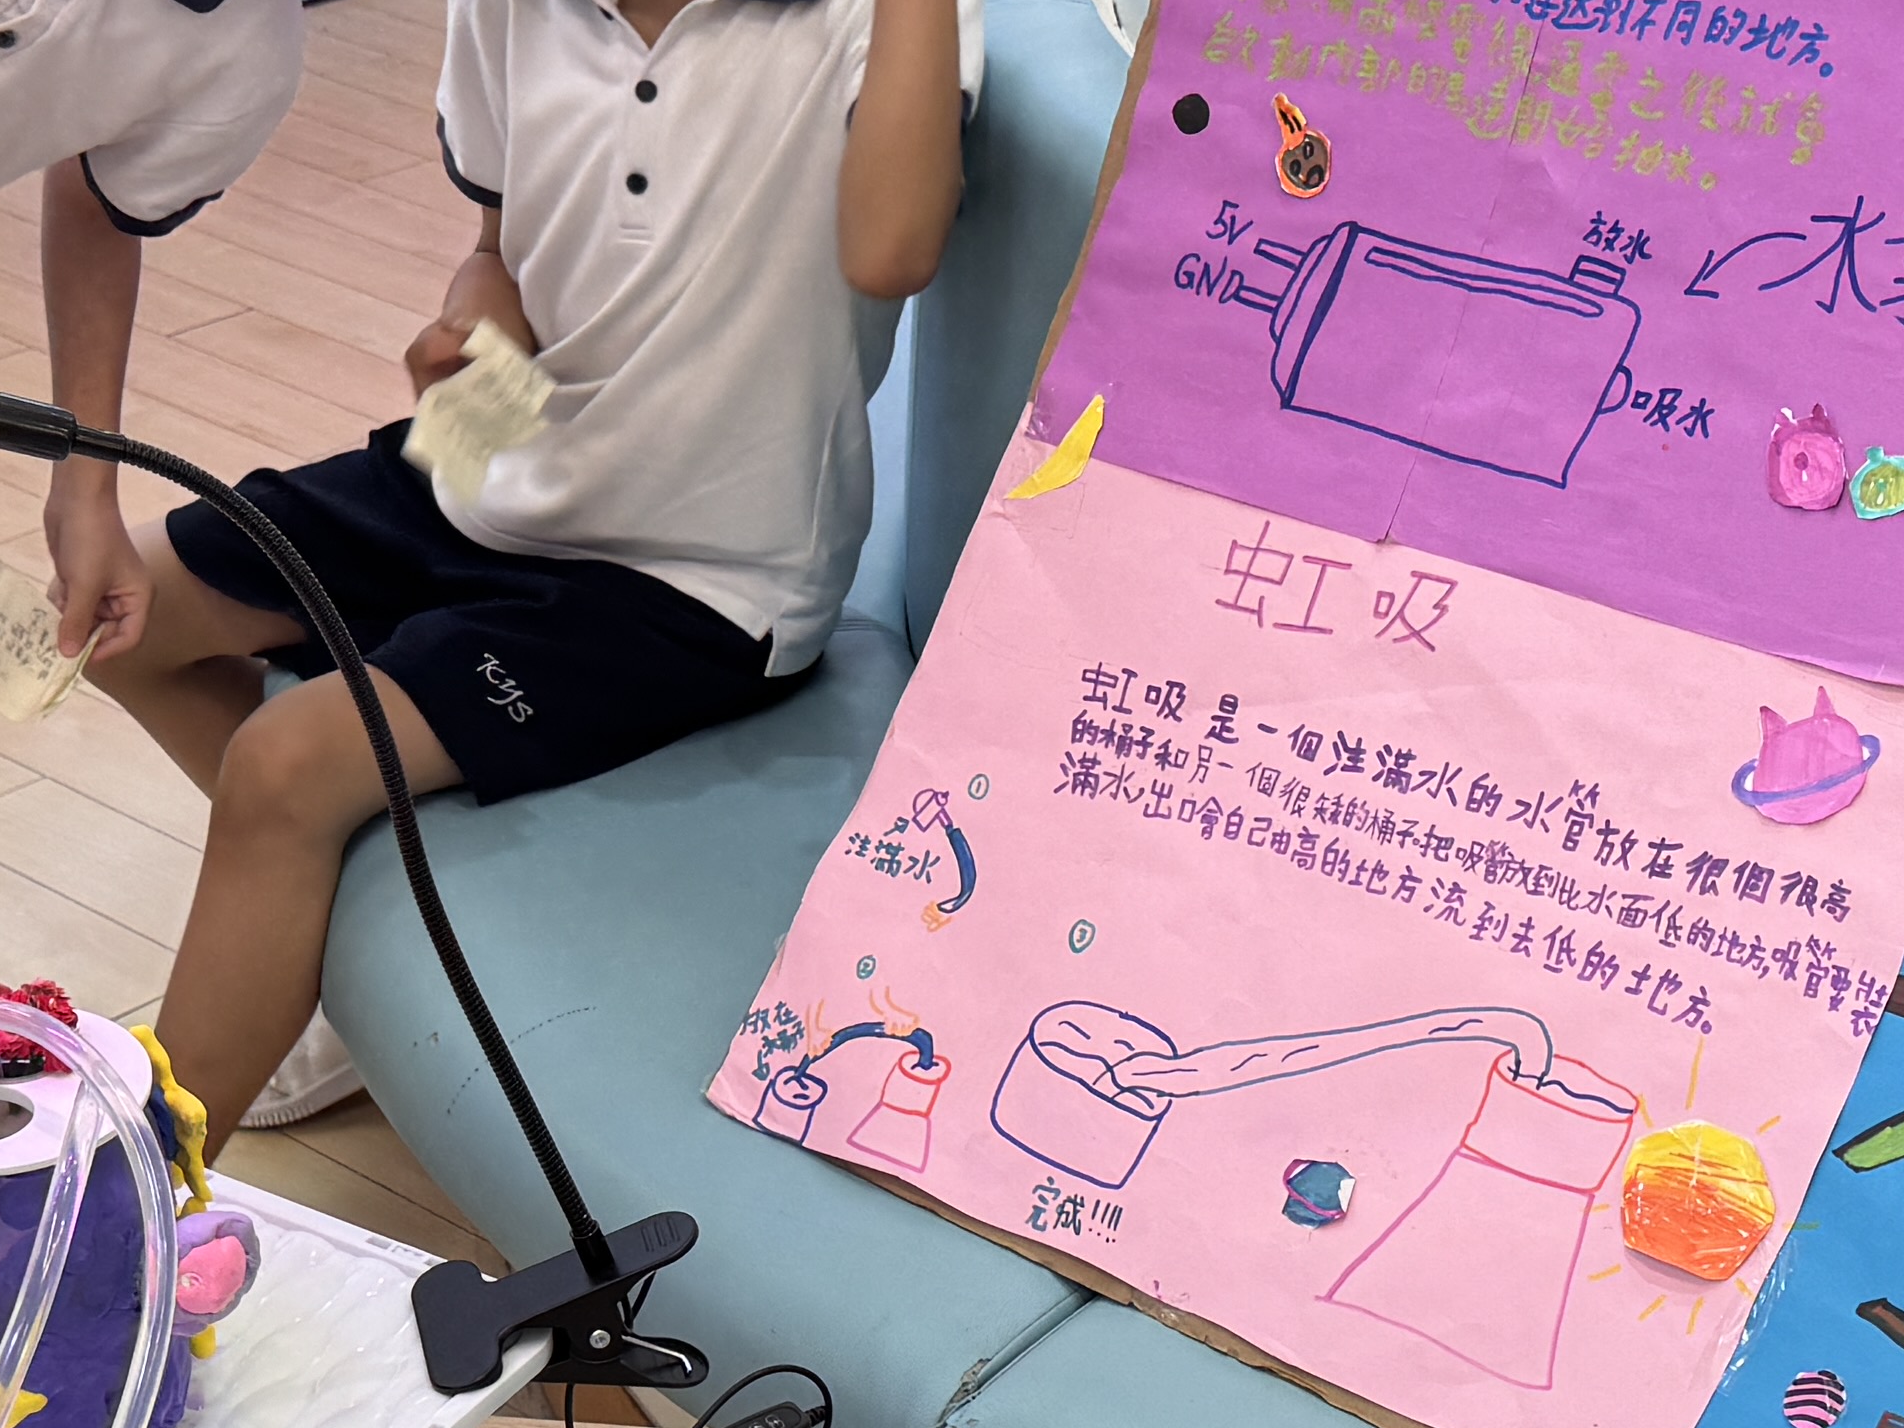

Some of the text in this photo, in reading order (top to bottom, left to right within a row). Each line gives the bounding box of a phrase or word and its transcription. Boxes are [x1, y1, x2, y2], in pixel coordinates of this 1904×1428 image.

[1588, 210, 1653, 263] 放水
[1173, 254, 1242, 306] GND
[1630, 388, 1714, 439] 吸水
[1215, 520, 1459, 653] 虹吸
[844, 832, 941, 884] 注滿水
